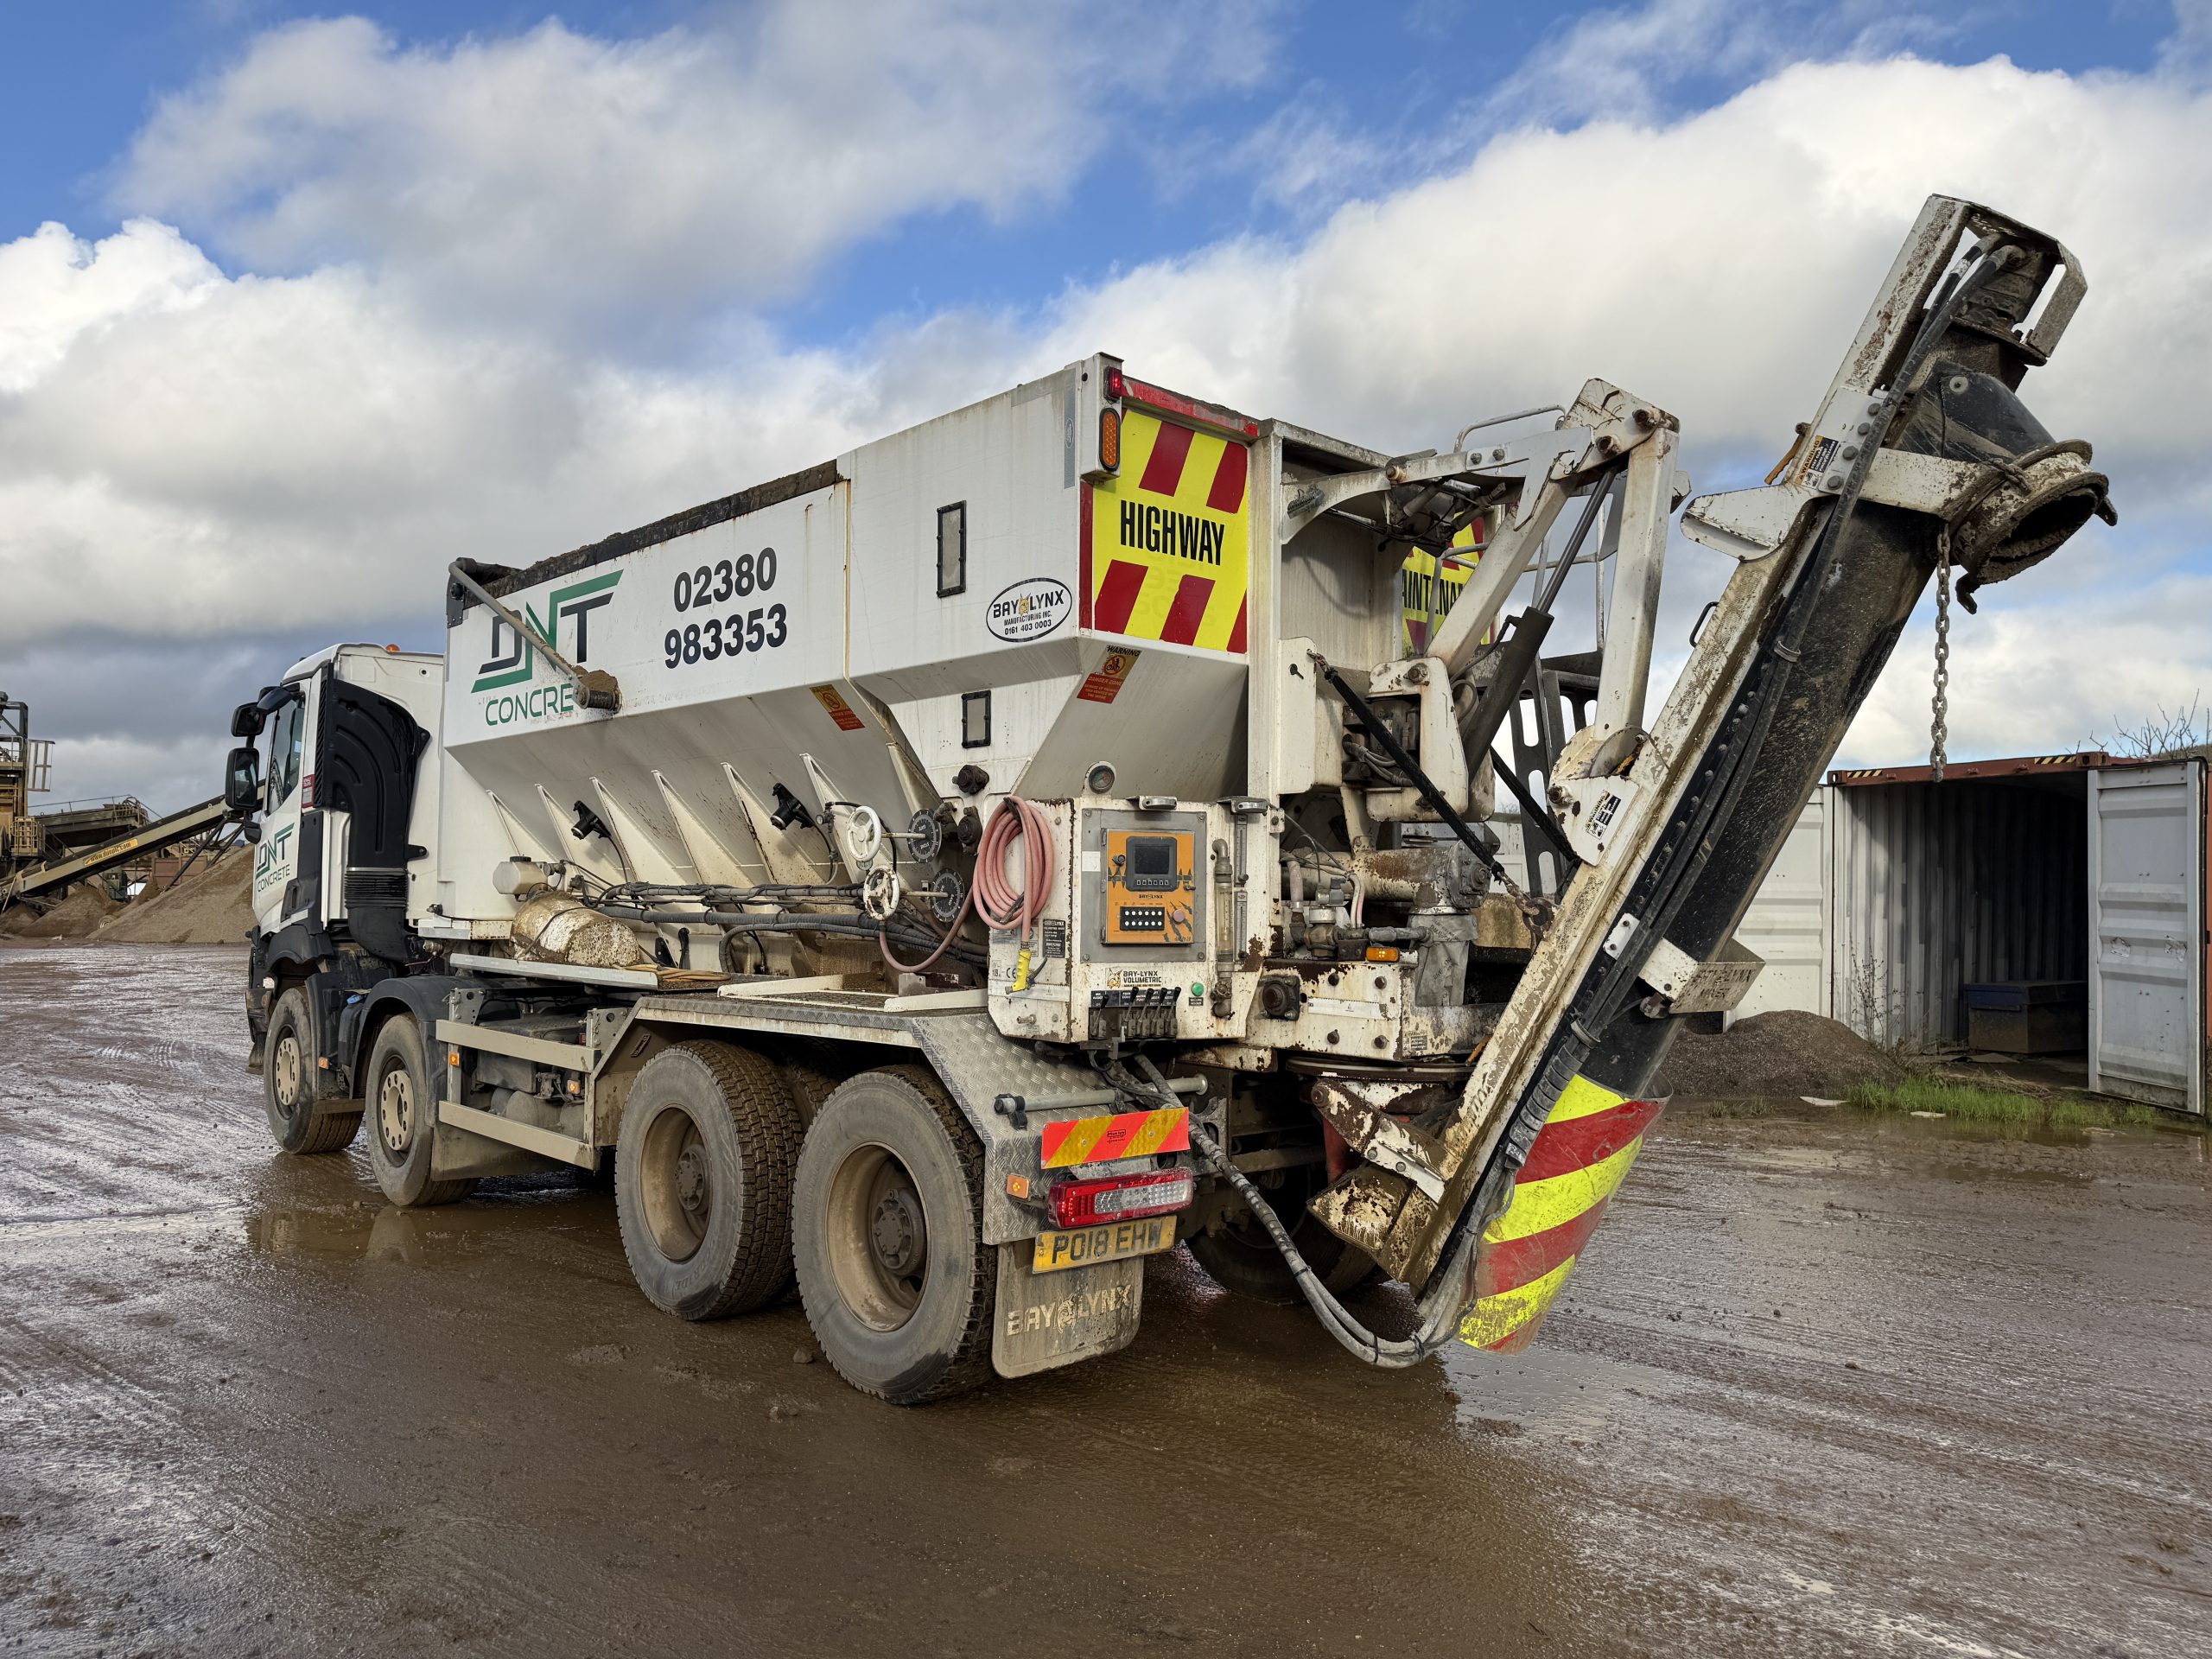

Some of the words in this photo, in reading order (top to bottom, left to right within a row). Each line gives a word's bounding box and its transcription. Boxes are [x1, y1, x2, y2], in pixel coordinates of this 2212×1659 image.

[1121, 499, 1224, 566] HIGHWAY
[674, 547, 777, 613] 02380
[993, 599, 1019, 619] BAY
[1029, 589, 1064, 611] LYNX
[1004, 613, 1042, 626] MANUFACTURING
[664, 603, 787, 669] 983353
[1005, 626, 1018, 635] 0161
[1020, 623, 1033, 632] 403
[1035, 620, 1052, 629] 0003
[1107, 645, 1141, 657] WARNING
[486, 683, 575, 727] CONCRE
[257, 864, 290, 893] CONCRETE
[1007, 1303, 1056, 1337] BAY
[1076, 1284, 1131, 1319] LYNX
